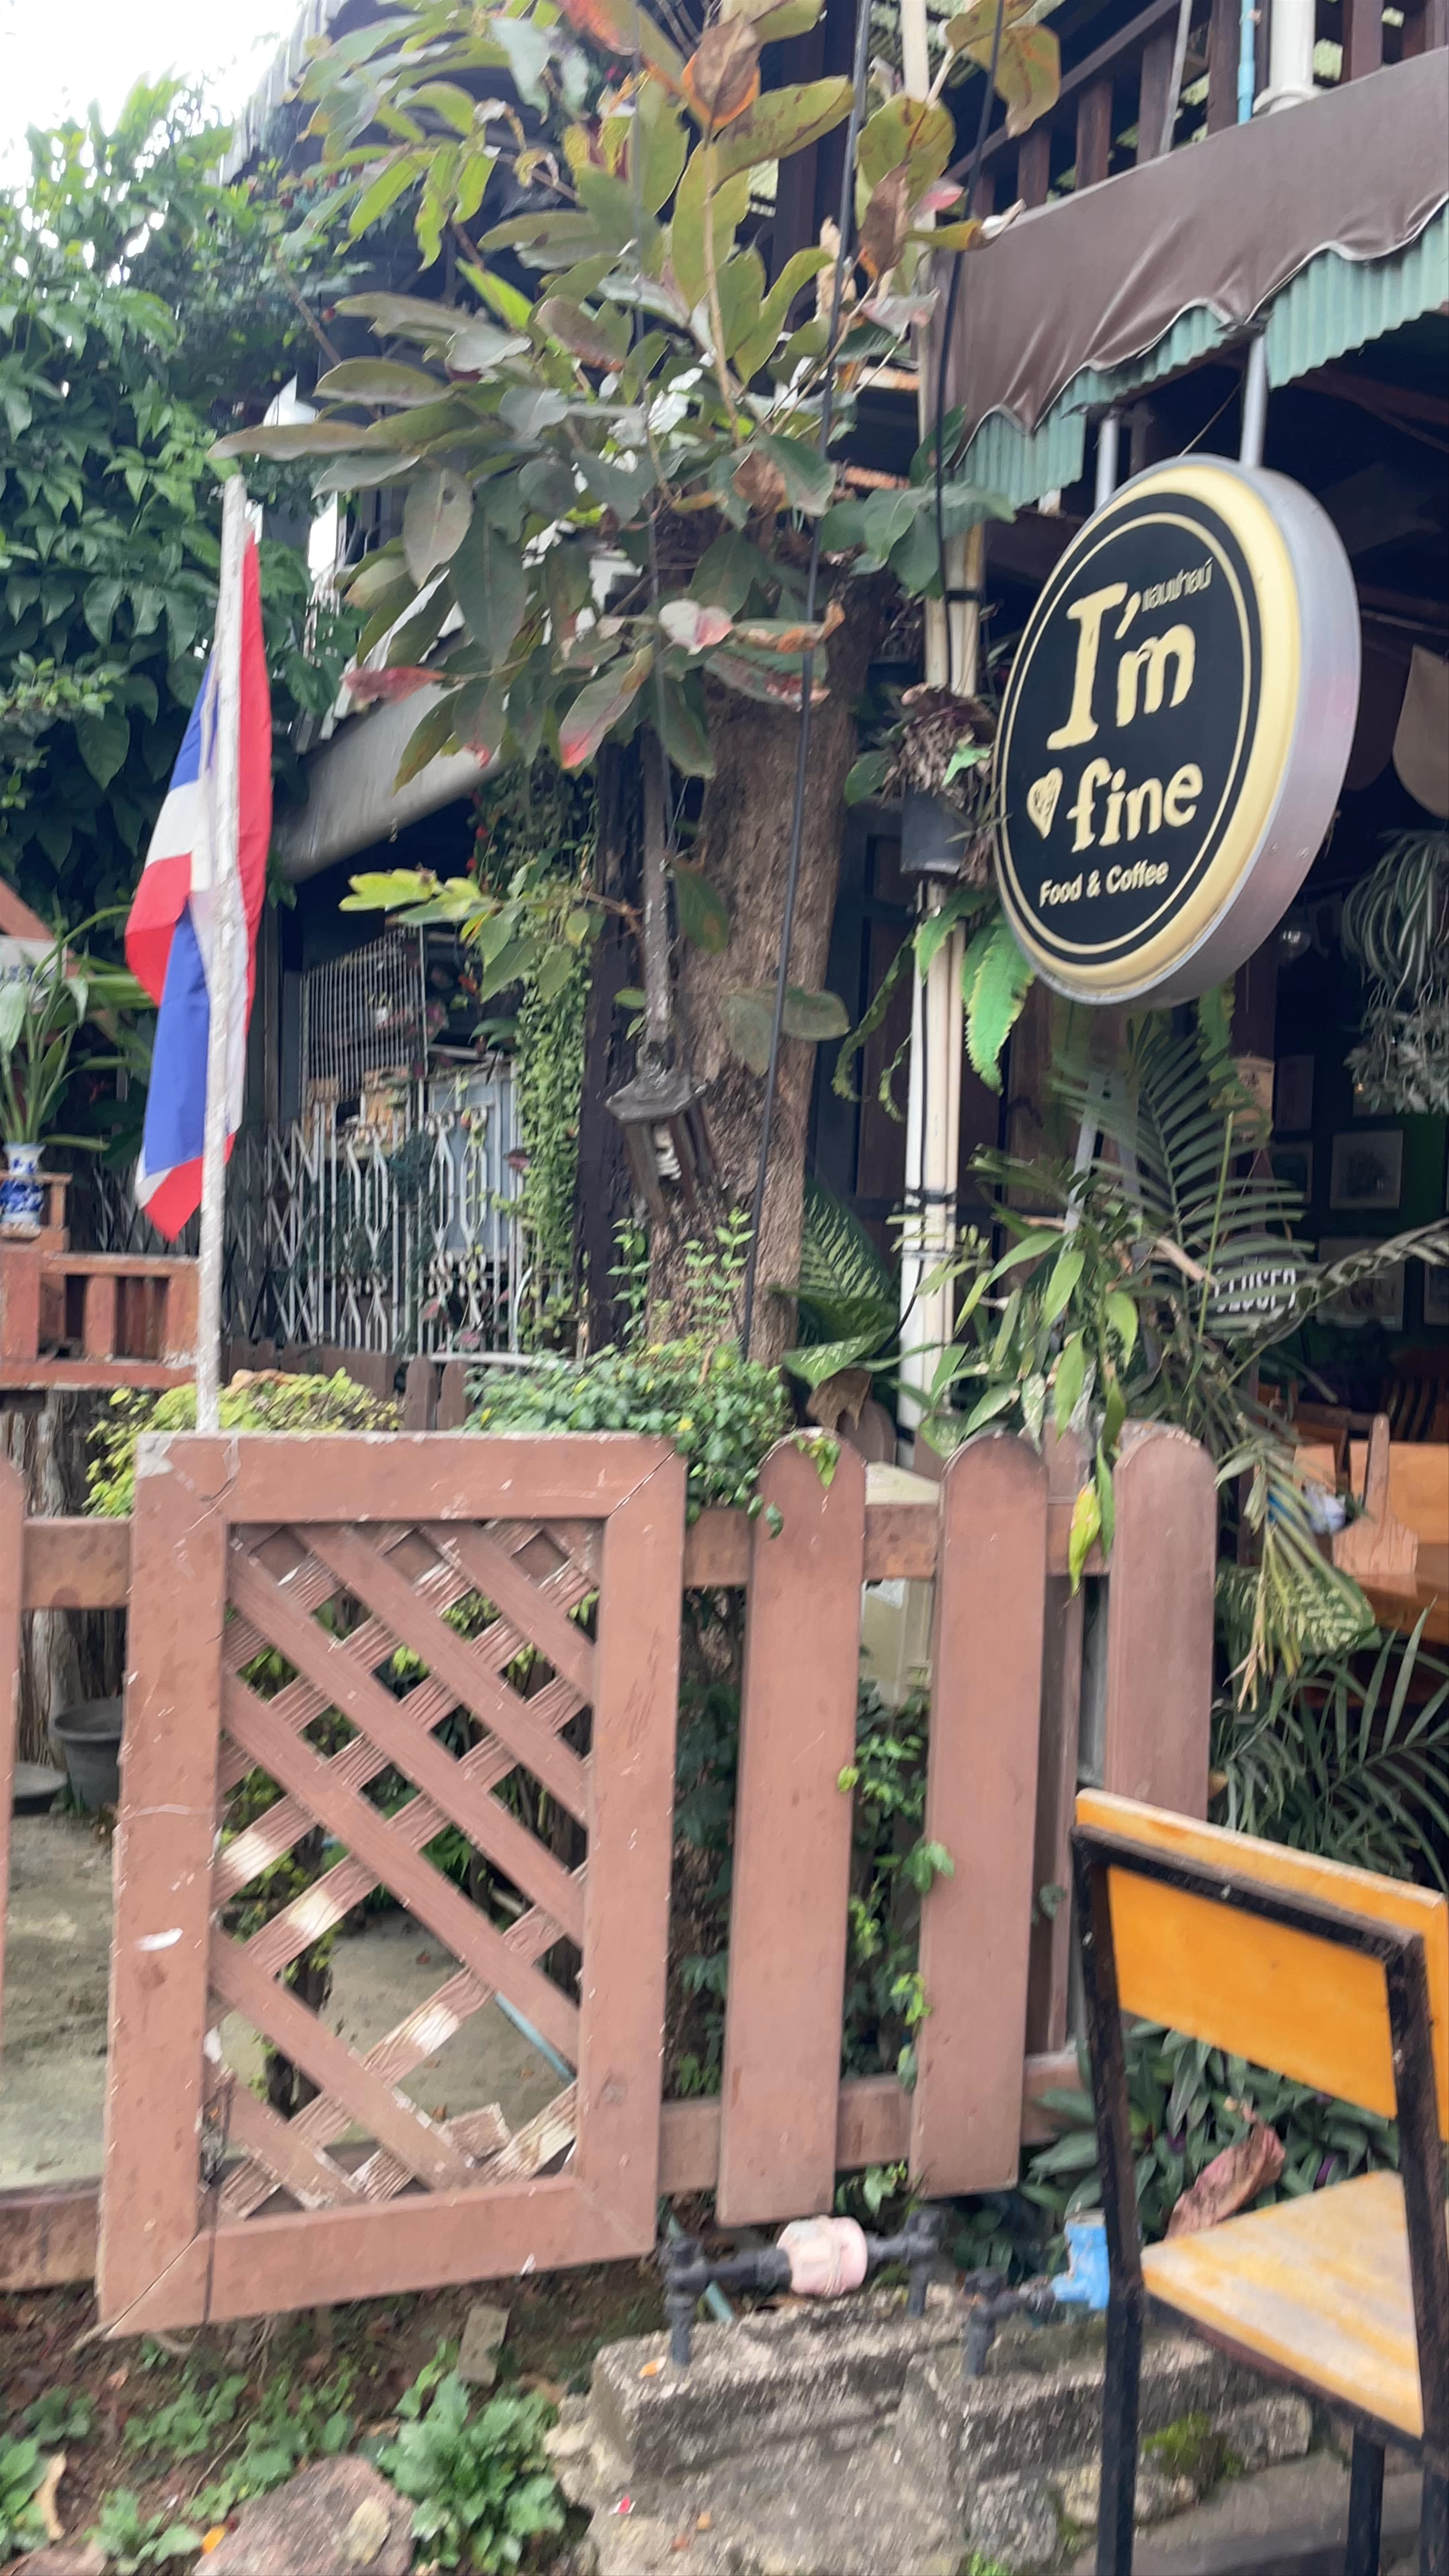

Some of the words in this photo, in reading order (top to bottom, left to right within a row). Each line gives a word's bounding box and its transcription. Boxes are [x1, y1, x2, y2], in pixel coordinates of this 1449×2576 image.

[1047, 582, 1196, 750] I'm
[1066, 758, 1203, 853] fine
[1040, 872, 1083, 908] Food
[1086, 869, 1101, 898] &
[1106, 859, 1169, 894] Coffee
